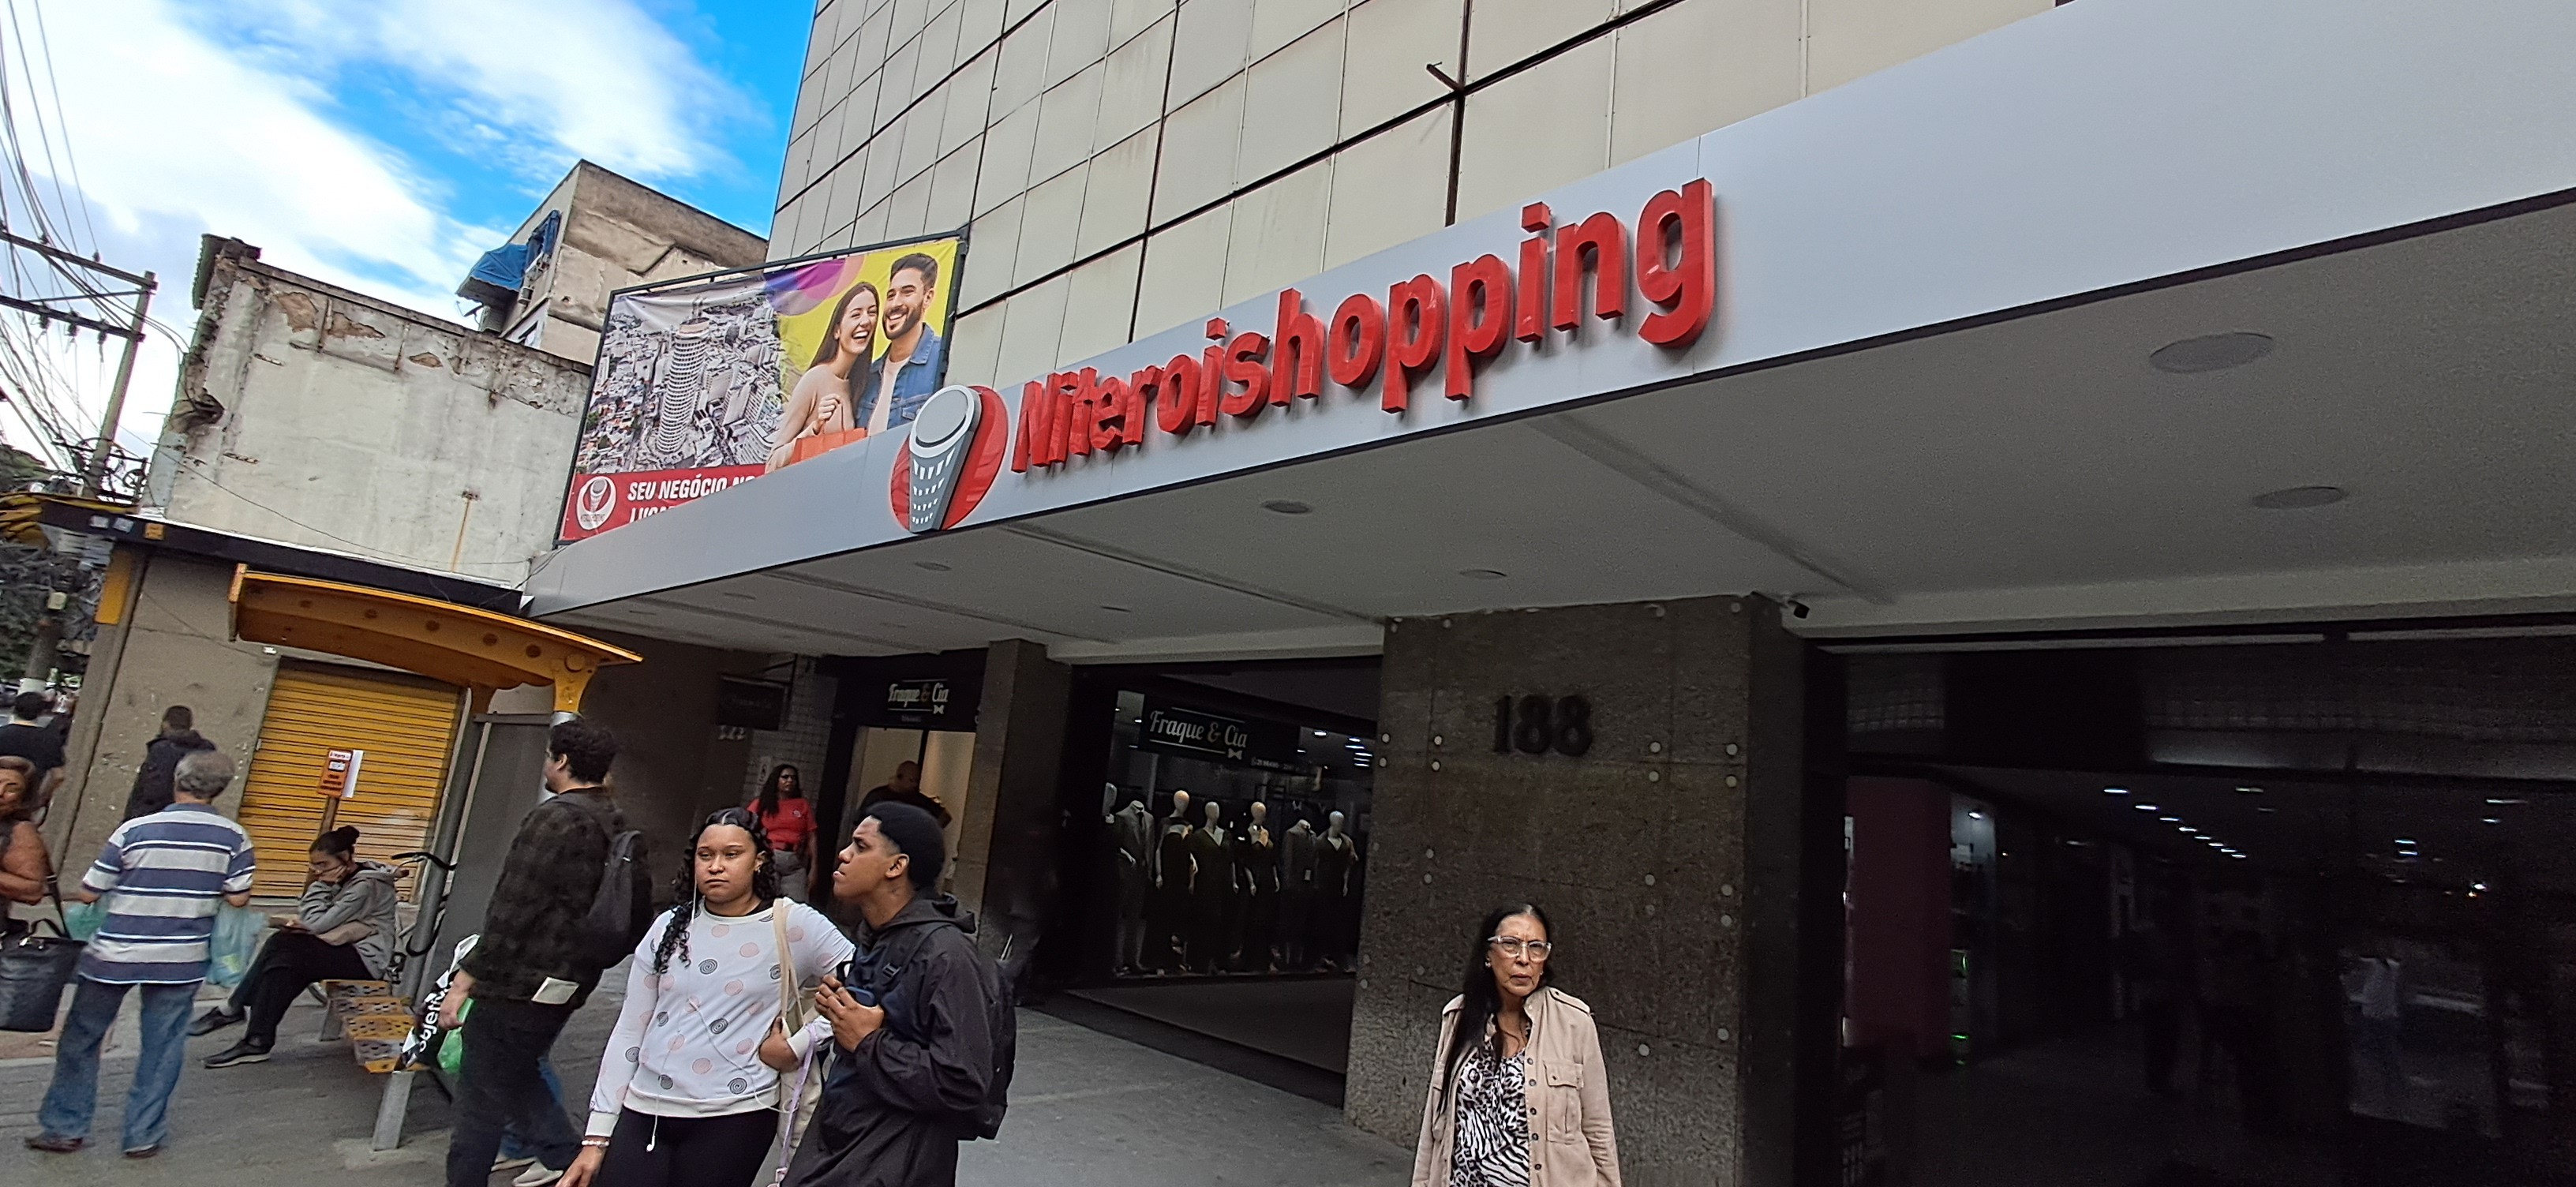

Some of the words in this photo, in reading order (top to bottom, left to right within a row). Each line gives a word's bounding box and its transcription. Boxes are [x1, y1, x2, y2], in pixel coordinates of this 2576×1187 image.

[627, 481, 657, 501] SEU
[658, 474, 728, 500] NEGÓCIO
[1149, 710, 1205, 743] Fraque
[1207, 721, 1222, 743] &
[1224, 725, 1249, 748] Cia
[1494, 695, 1593, 756] 188
